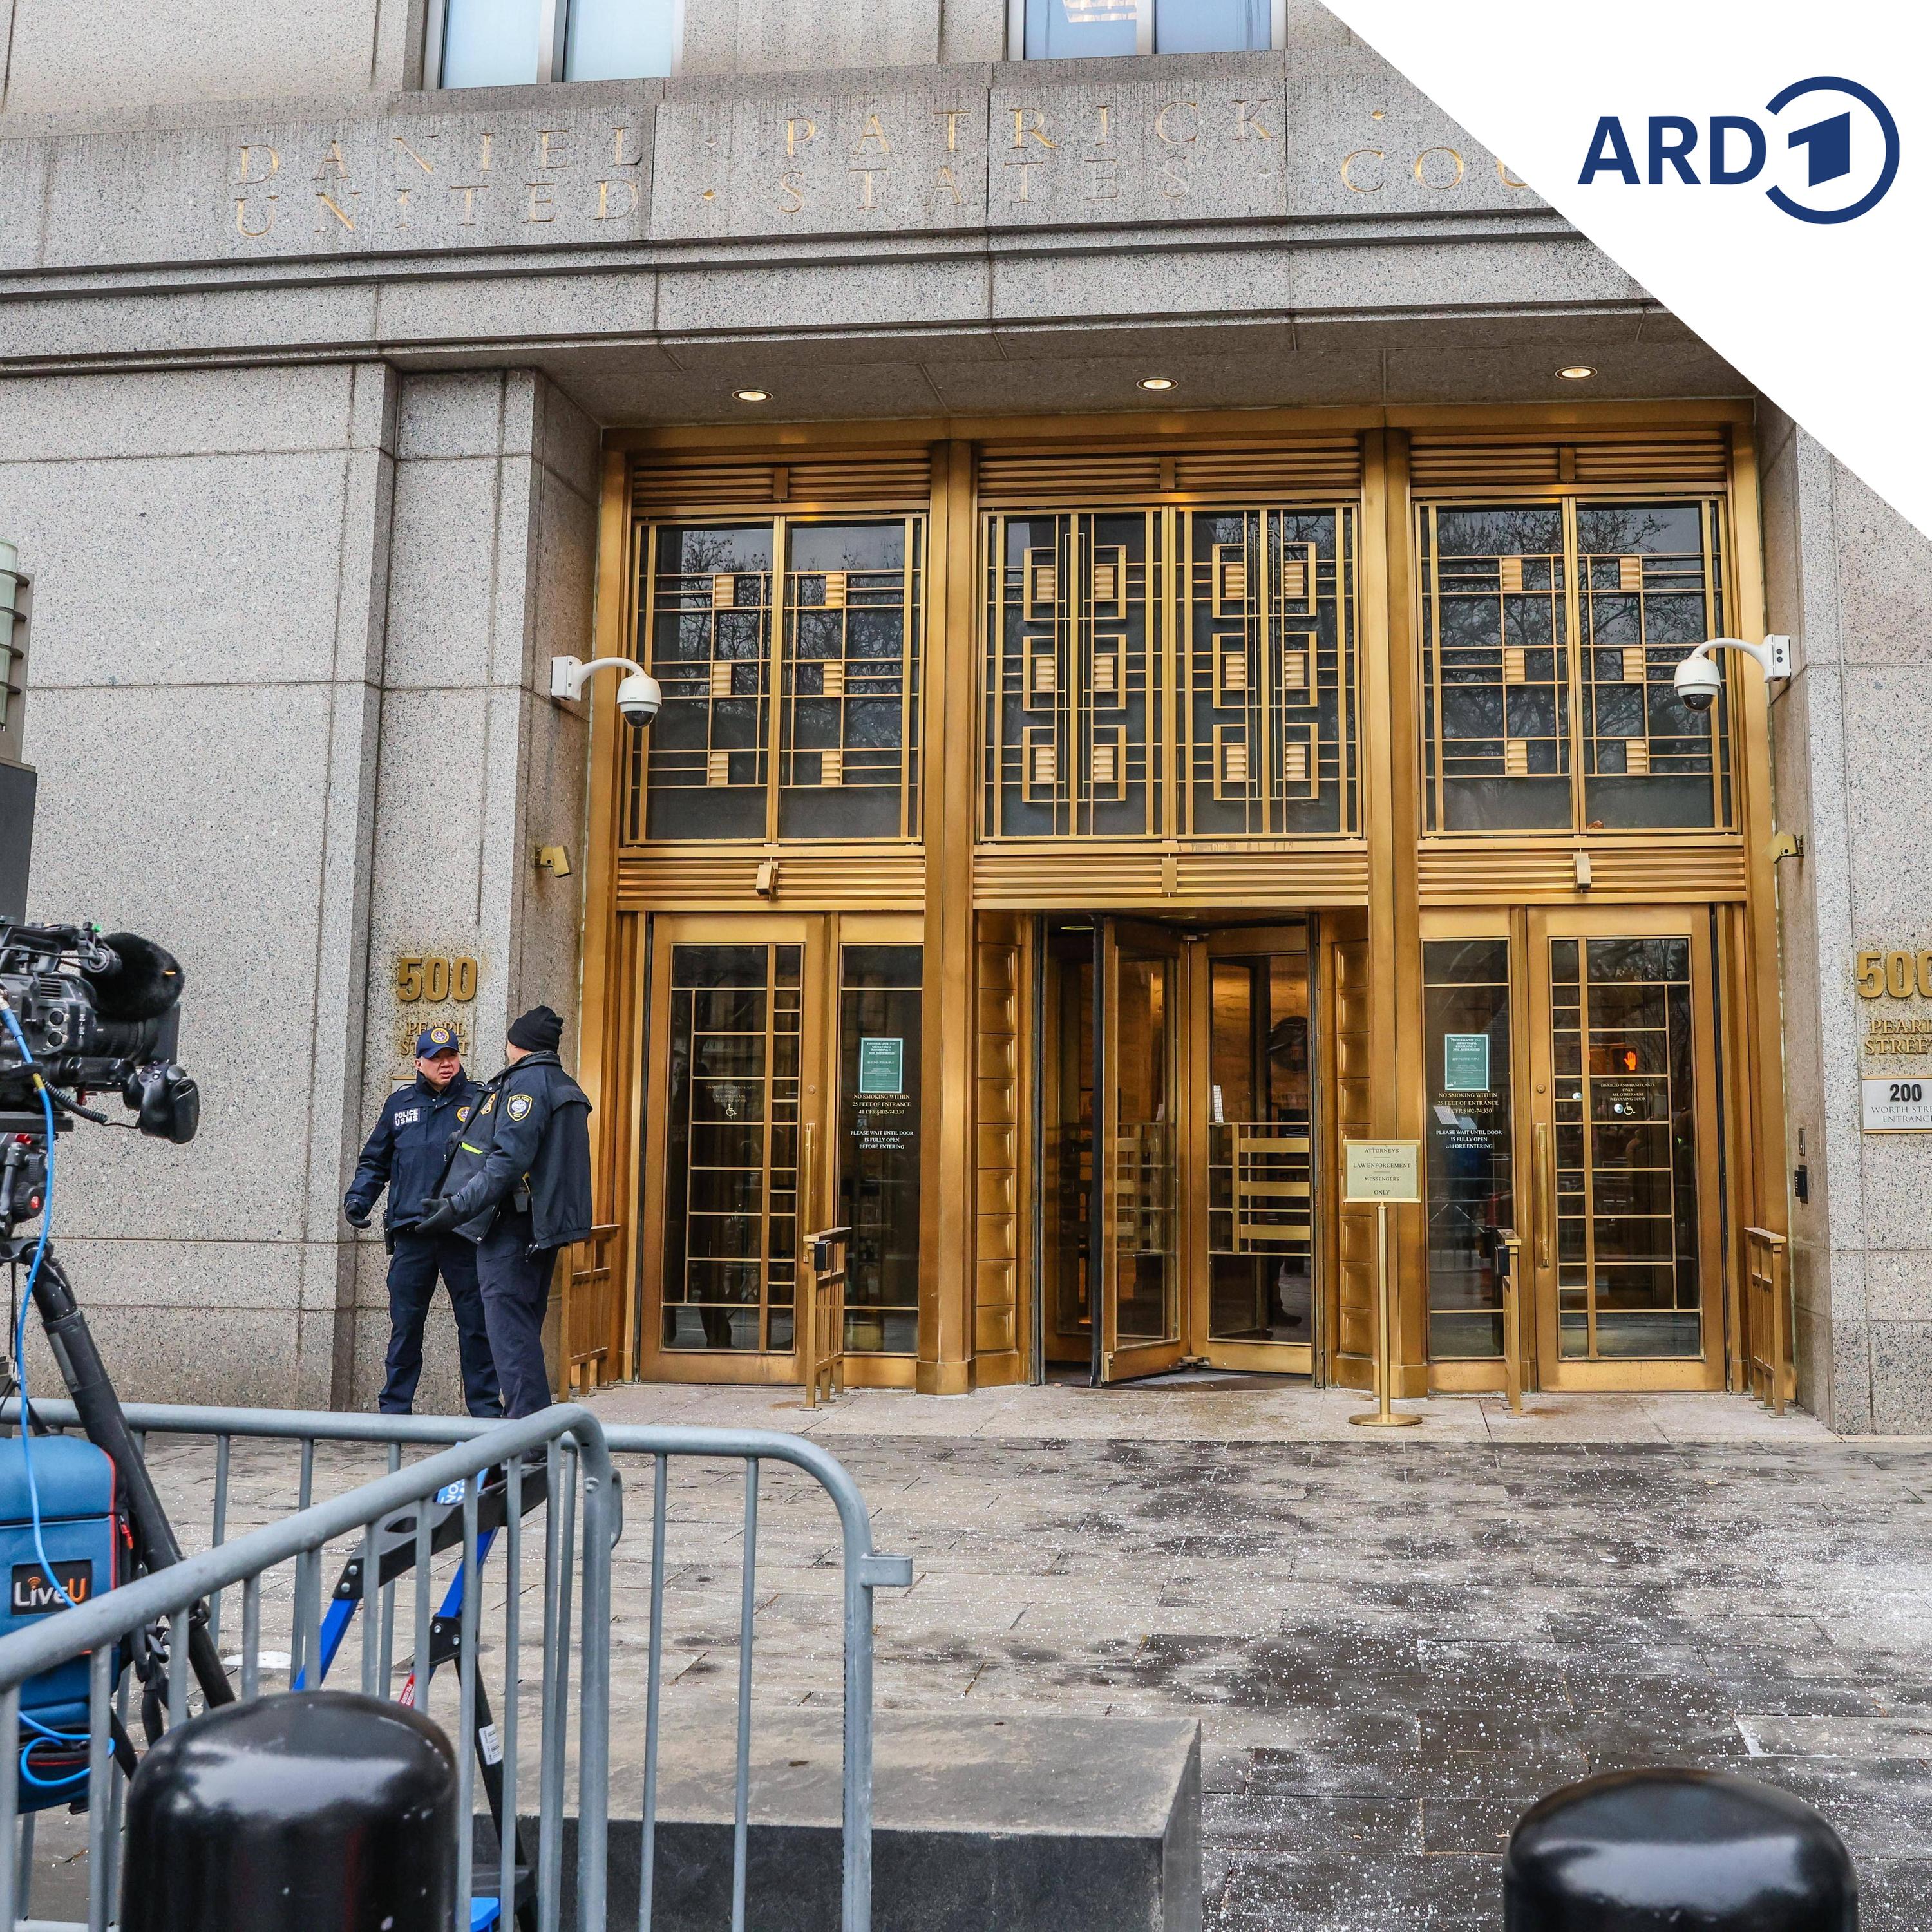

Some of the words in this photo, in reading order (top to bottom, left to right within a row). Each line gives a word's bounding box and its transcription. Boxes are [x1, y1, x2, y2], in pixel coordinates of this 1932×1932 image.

[235, 126, 643, 185] DANIEL
[781, 98, 1276, 159] PATRICK
[234, 178, 639, 238] UNITED
[778, 155, 1190, 214] STATES
[397, 956, 478, 1002] 500
[1857, 950, 1932, 998] 500
[401, 1040, 469, 1055] STT
[1865, 1039, 1932, 1055] STREE
[1889, 1084, 1922, 1102] 200
[394, 1109, 419, 1120] POLICE
[395, 1115, 419, 1126] USMS
[14, 1577, 87, 1607] LiveU
